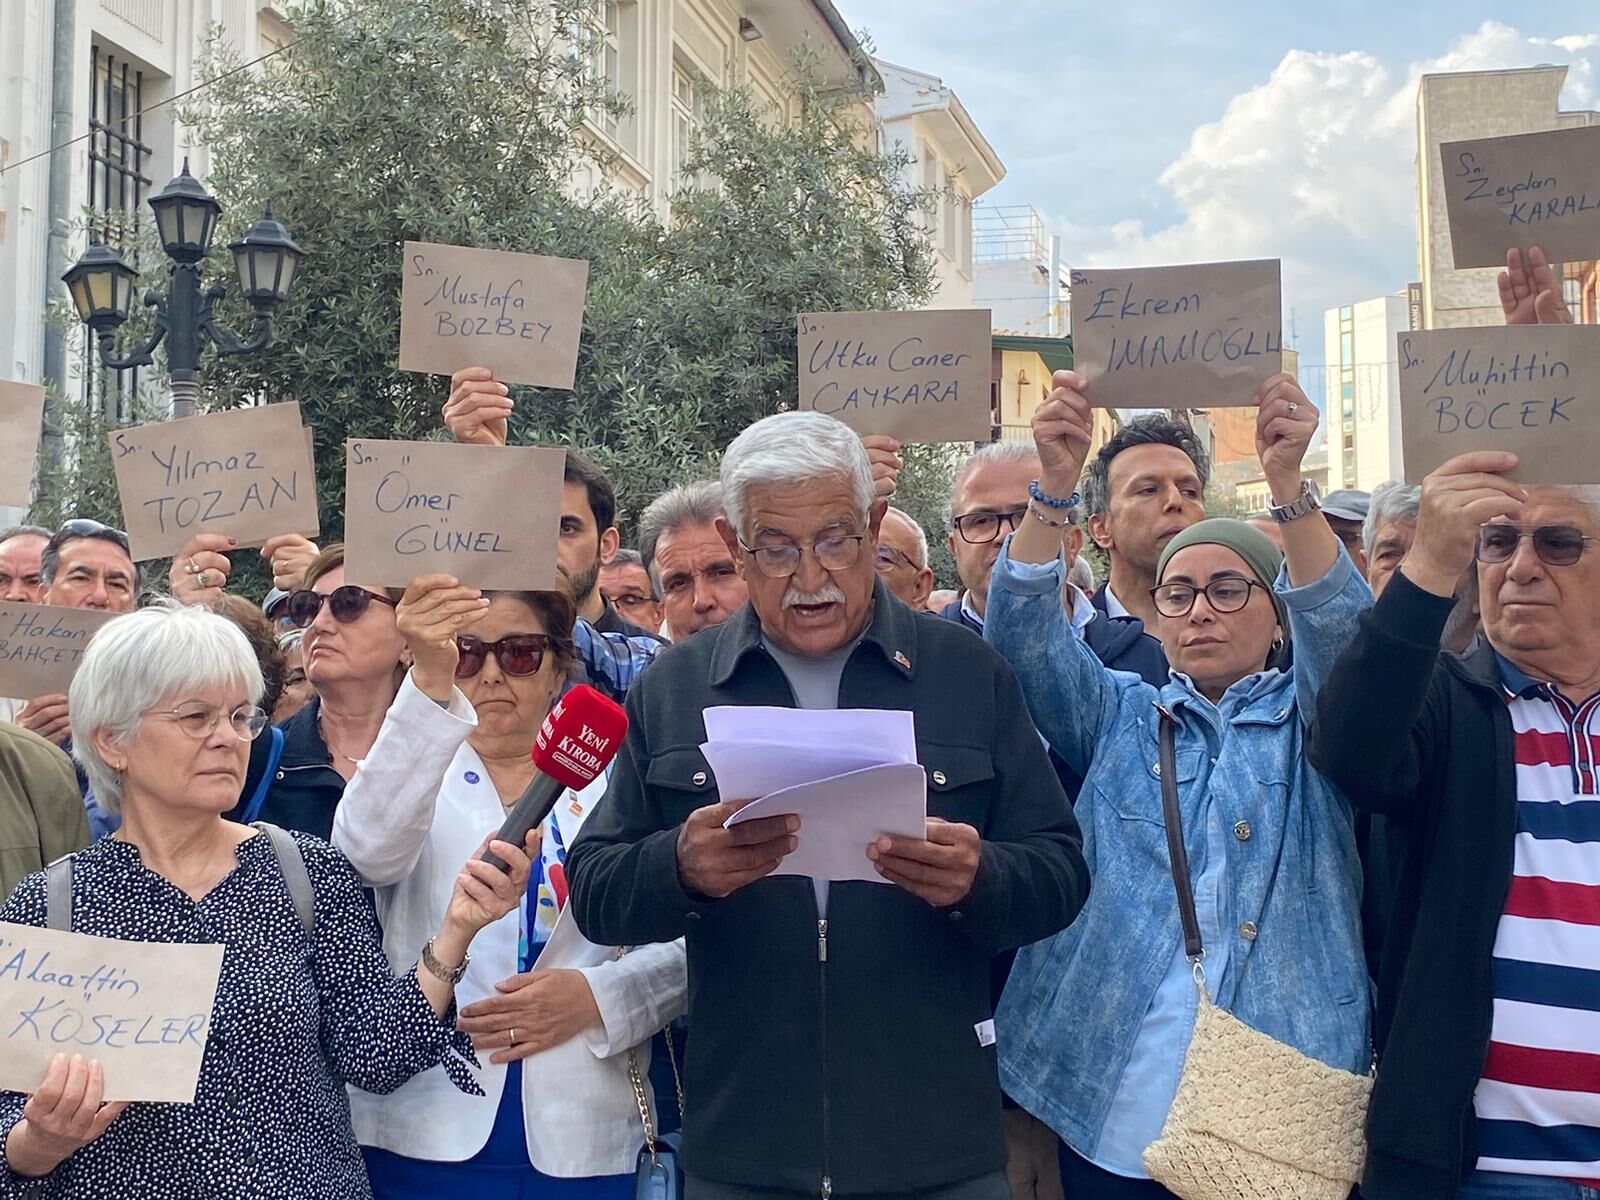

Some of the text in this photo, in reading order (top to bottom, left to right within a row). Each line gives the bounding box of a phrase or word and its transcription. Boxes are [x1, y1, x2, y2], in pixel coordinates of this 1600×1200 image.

[1464, 170, 1557, 204] Zeydan
[1509, 195, 1600, 226] KARAL
[412, 255, 440, 277] Sn.
[1071, 272, 1093, 285] Sn.
[424, 275, 525, 320] Mustafa
[1084, 282, 1200, 322] Ekrem
[436, 311, 552, 343] BOZBEY
[801, 317, 825, 335] Sn.
[809, 337, 973, 374] Utku Caner
[1107, 317, 1281, 373] İMAMOĞLU
[1402, 339, 1424, 370] Sn.
[1424, 349, 1569, 394] Muhittin
[1426, 388, 1575, 434] BÖCEK
[116, 434, 143, 457] Sn.
[353, 443, 378, 465] Sn.
[144, 471, 297, 533] TOZAN
[375, 456, 464, 513] Ömer
[394, 518, 512, 555] GÜNEL
[9, 613, 87, 638] Hakan
[0, 639, 85, 665] BAHÇET
[557, 735, 602, 771] KIROBA
[578, 724, 610, 753] YENİ
[0, 948, 140, 999] Alaattin
[8, 992, 207, 1049] KÖSELER
